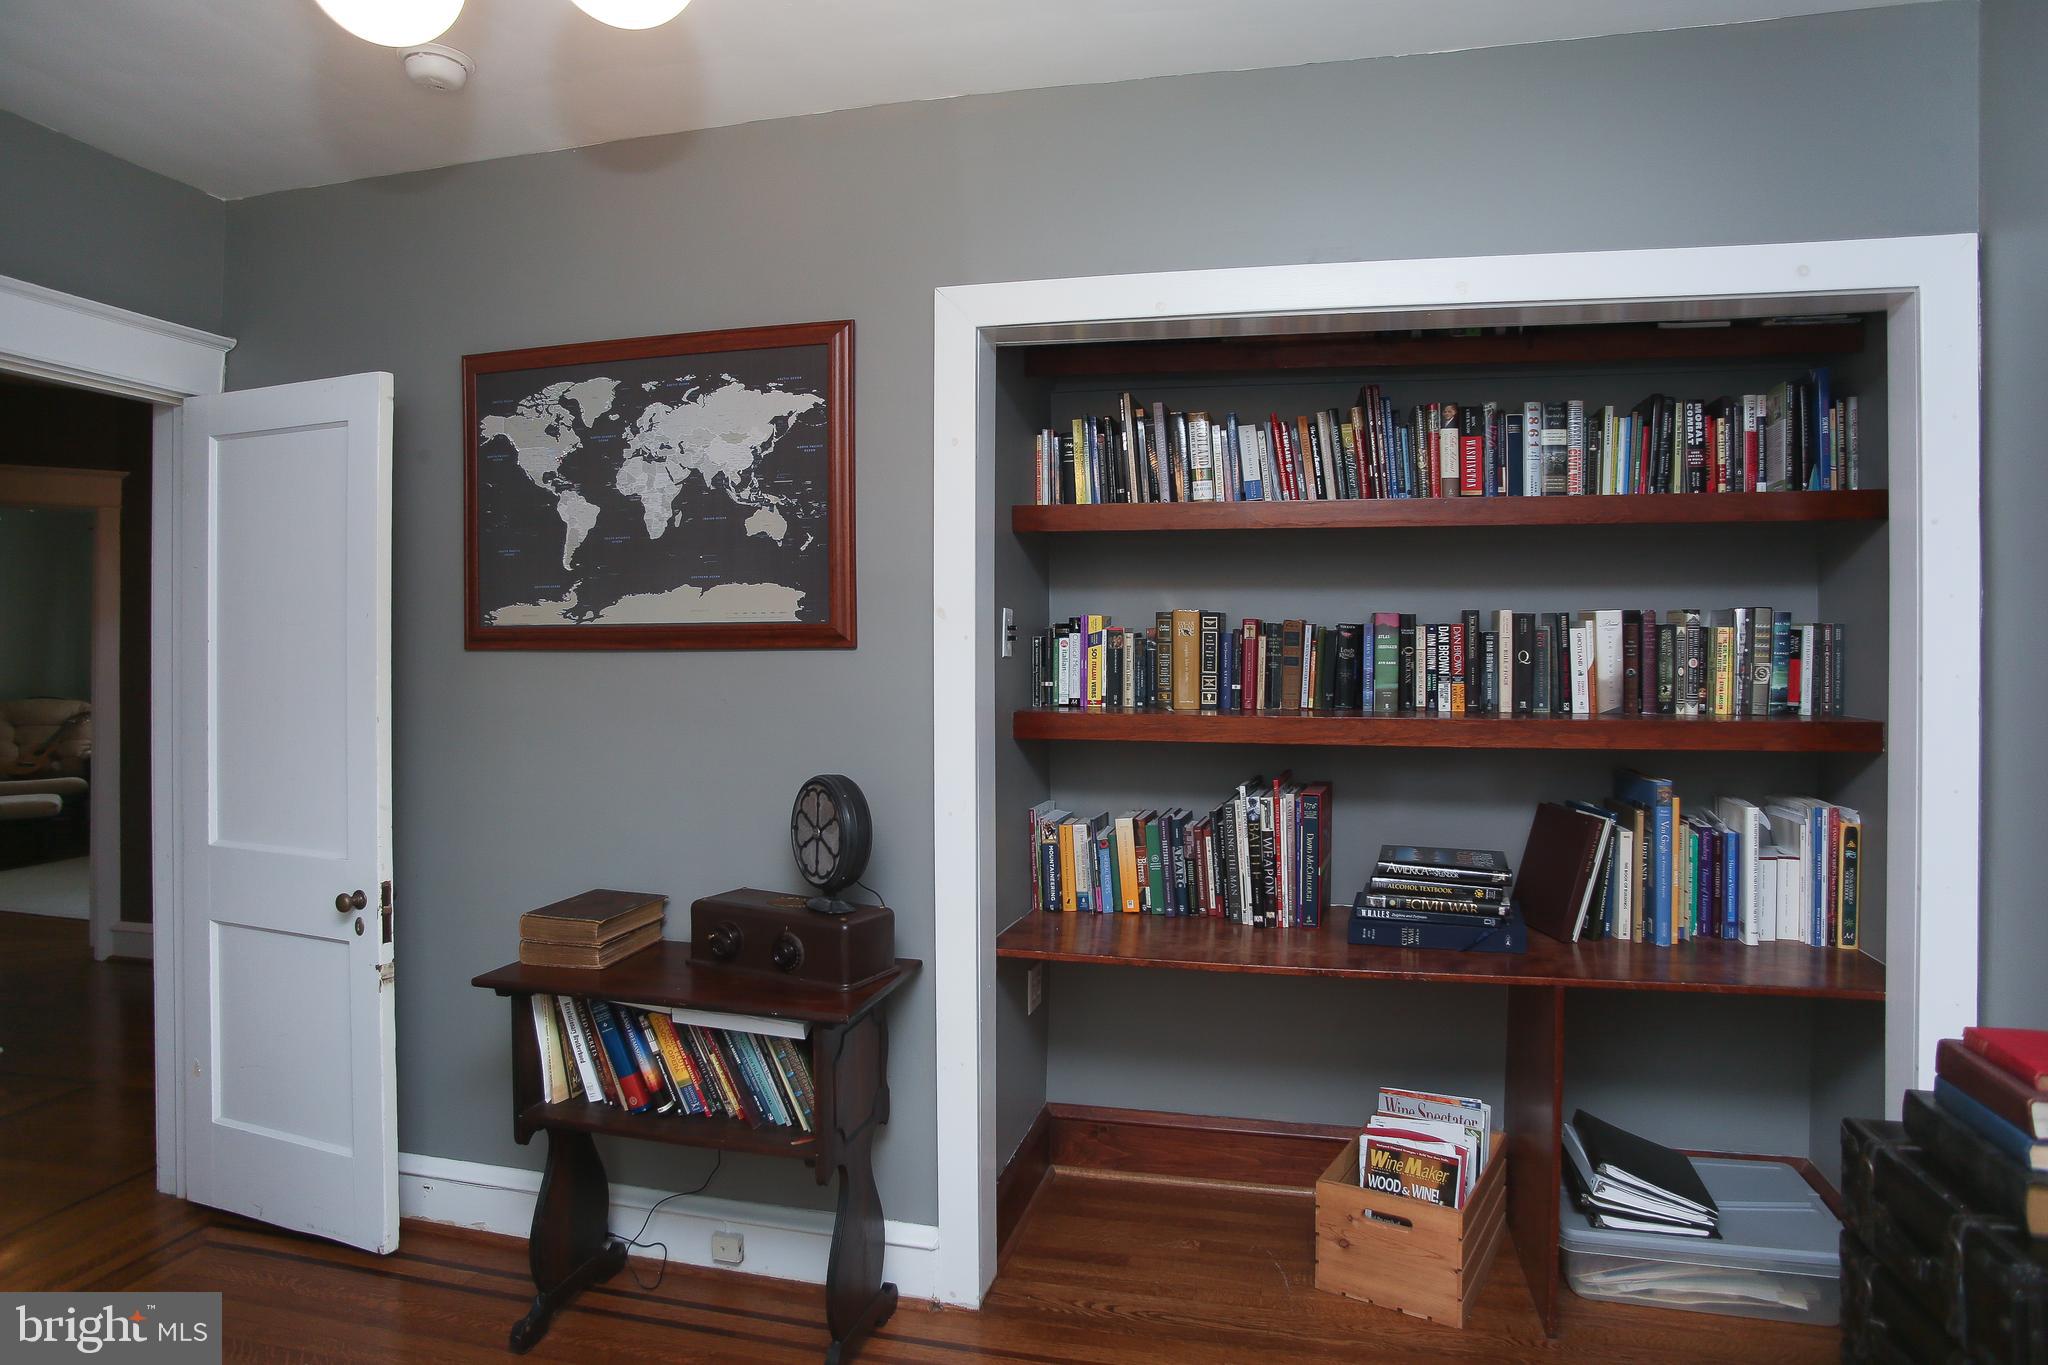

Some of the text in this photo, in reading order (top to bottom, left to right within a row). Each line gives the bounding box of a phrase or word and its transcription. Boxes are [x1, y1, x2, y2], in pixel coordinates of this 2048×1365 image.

[1195, 422, 1209, 468] SCOTLAND
[1528, 405, 1540, 449] 1861
[1686, 403, 1694, 446] COMBAT
[1694, 403, 1703, 446] MORAL
[1345, 441, 1357, 487] Mayflower
[1465, 439, 1476, 488] WASHINGTON
[1567, 449, 1578, 493] CIVIL WAR
[1427, 633, 1437, 670] DAN BROWN
[1438, 626, 1450, 674] DAN BROWN
[1453, 626, 1462, 675] DAN BROWN
[1486, 641, 1494, 652] DAN
[1486, 653, 1494, 672] BROWN
[1517, 650, 1531, 665] Q
[1225, 807, 1238, 896] DRESSING THE MAN
[1247, 822, 1261, 879] BATTLE
[1658, 821, 1670, 854] Van Gogh
[1048, 845, 1056, 901] MOUNTAINEERING
[1173, 846, 1184, 888] AMARO
[1263, 837, 1274, 895] WEAPON
[1375, 881, 1453, 895] THE ALCOHOL TEXTBOOK
[1448, 902, 1479, 914] WAR
[1360, 909, 1390, 919] WHALES
[564, 1001, 587, 1064] Revolutionary Brotherhood
[584, 1028, 597, 1057] SECRETS
[1384, 1096, 1415, 1115] Wine
[1369, 1148, 1404, 1172] Wine
[1404, 1156, 1450, 1183] Maker
[1367, 1173, 1440, 1204] WOOD & WINE!
